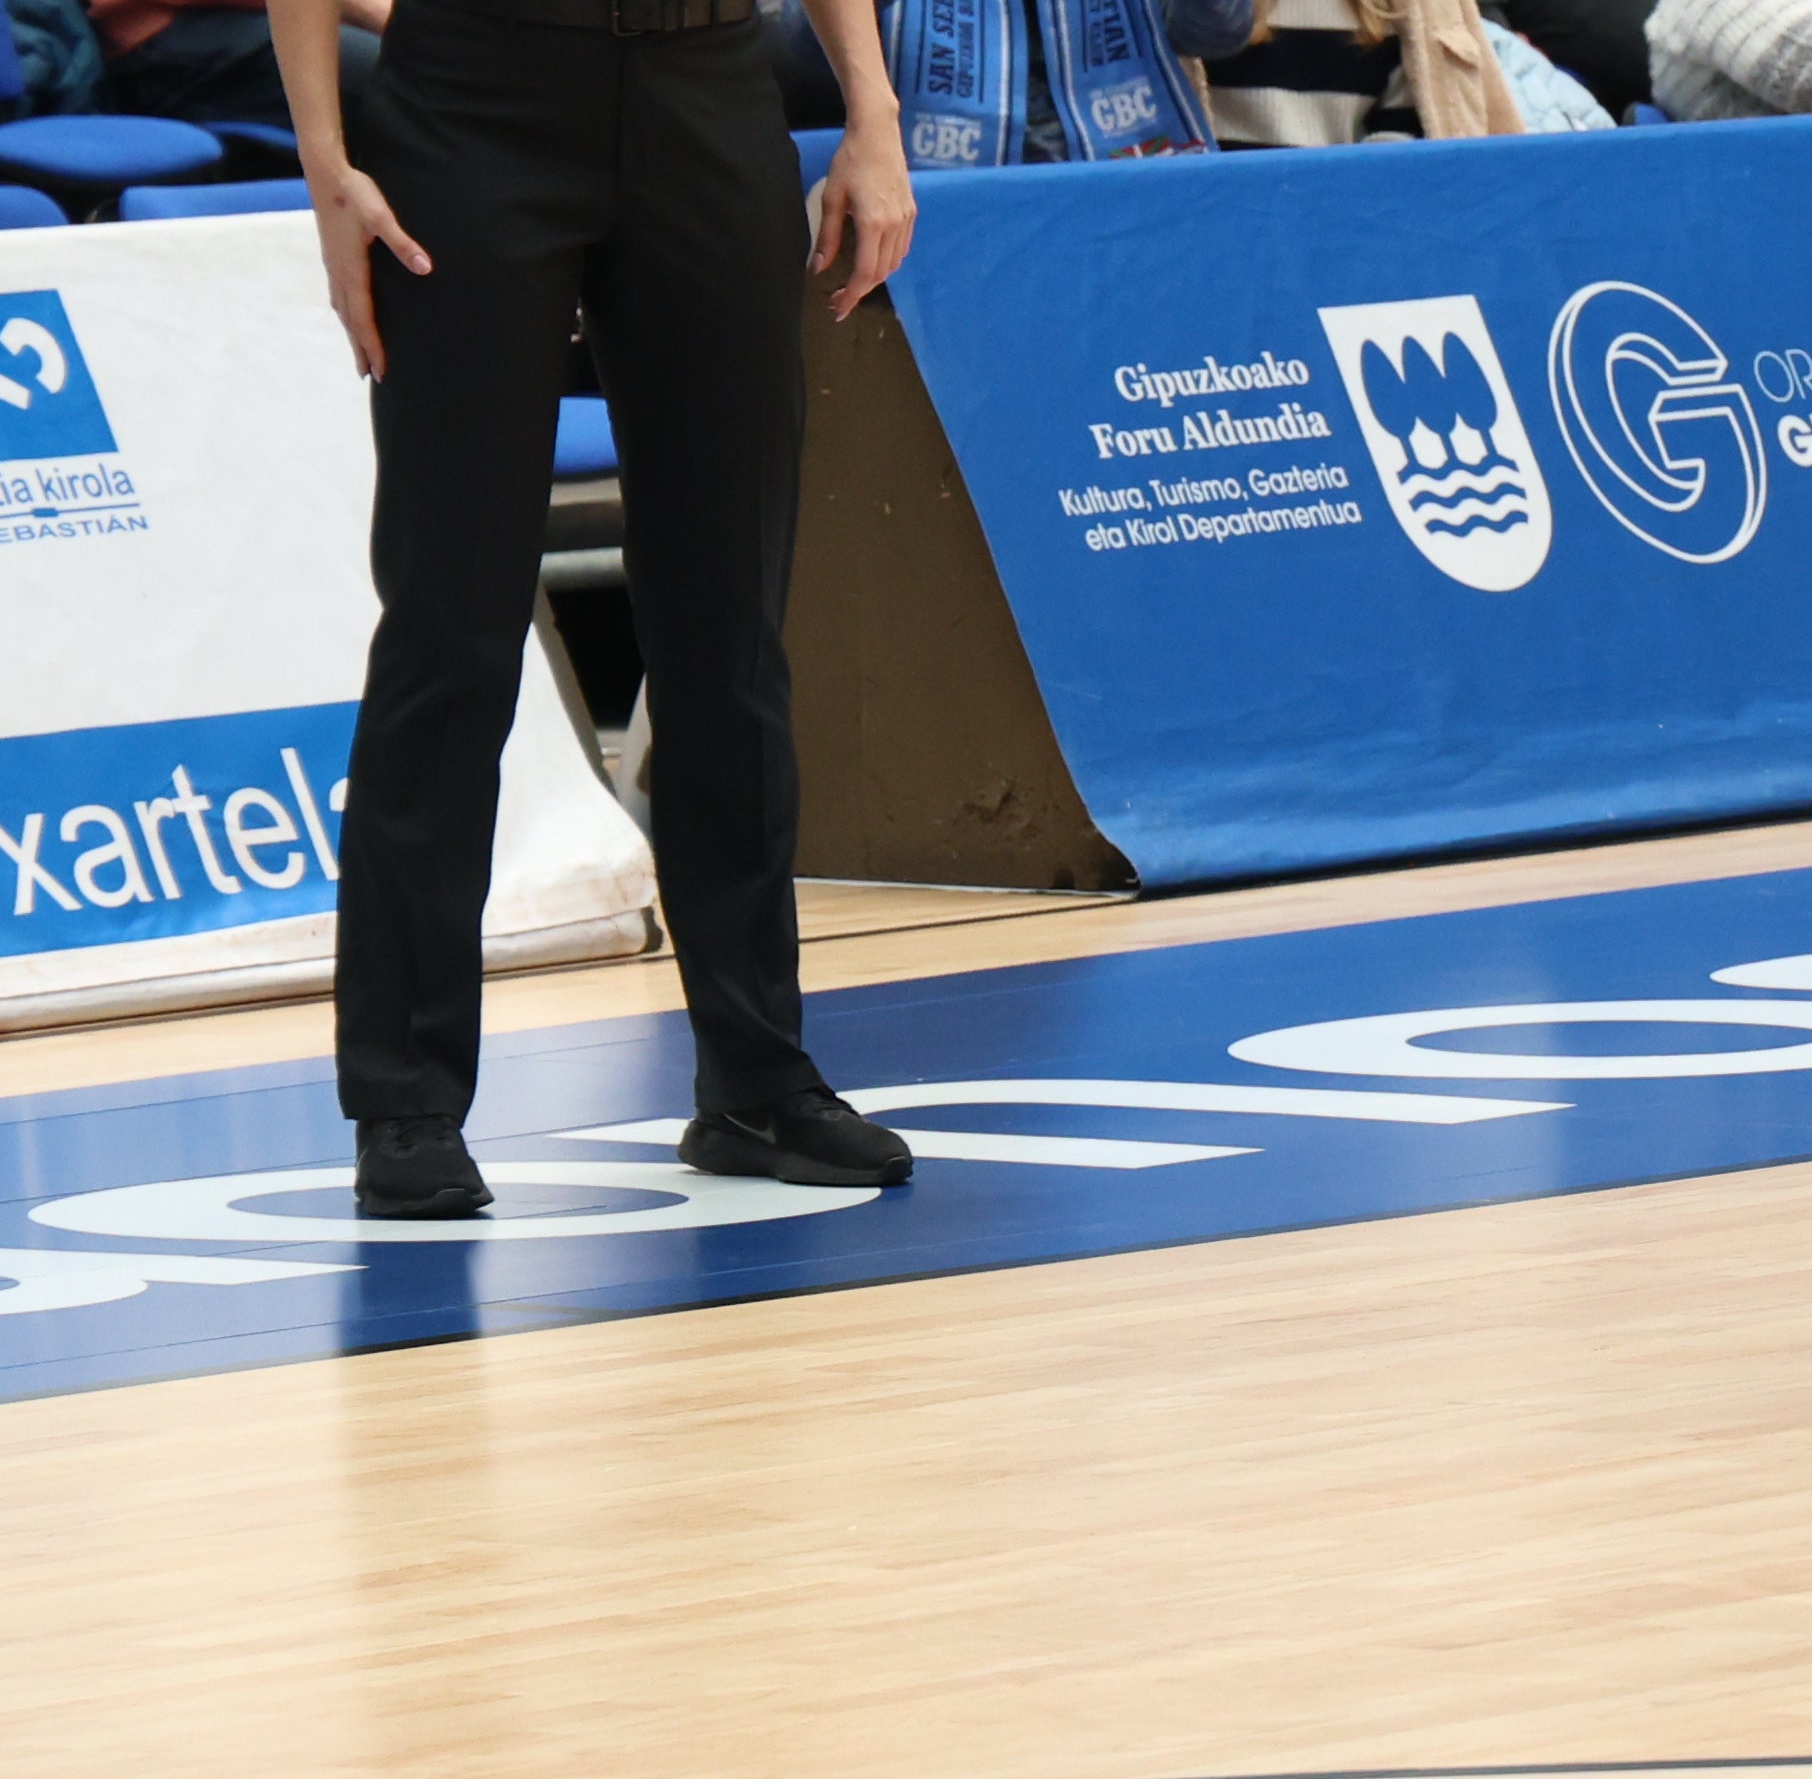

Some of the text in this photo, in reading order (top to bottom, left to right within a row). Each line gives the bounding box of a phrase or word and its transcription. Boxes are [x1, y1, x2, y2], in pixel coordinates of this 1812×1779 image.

[1091, 85, 1157, 132] GBC
[912, 124, 983, 161] GBC
[1114, 351, 1310, 408] Gipuzkoako
[1088, 402, 1332, 459] Foru Aldundia
[36, 462, 135, 505] kirola
[1058, 463, 1350, 517] Kultura, Turismo, Gazteria
[0, 514, 149, 544] EBASTIÁN
[1085, 499, 1362, 552] eta Kirol Departamentua
[0, 749, 350, 917] xartel
